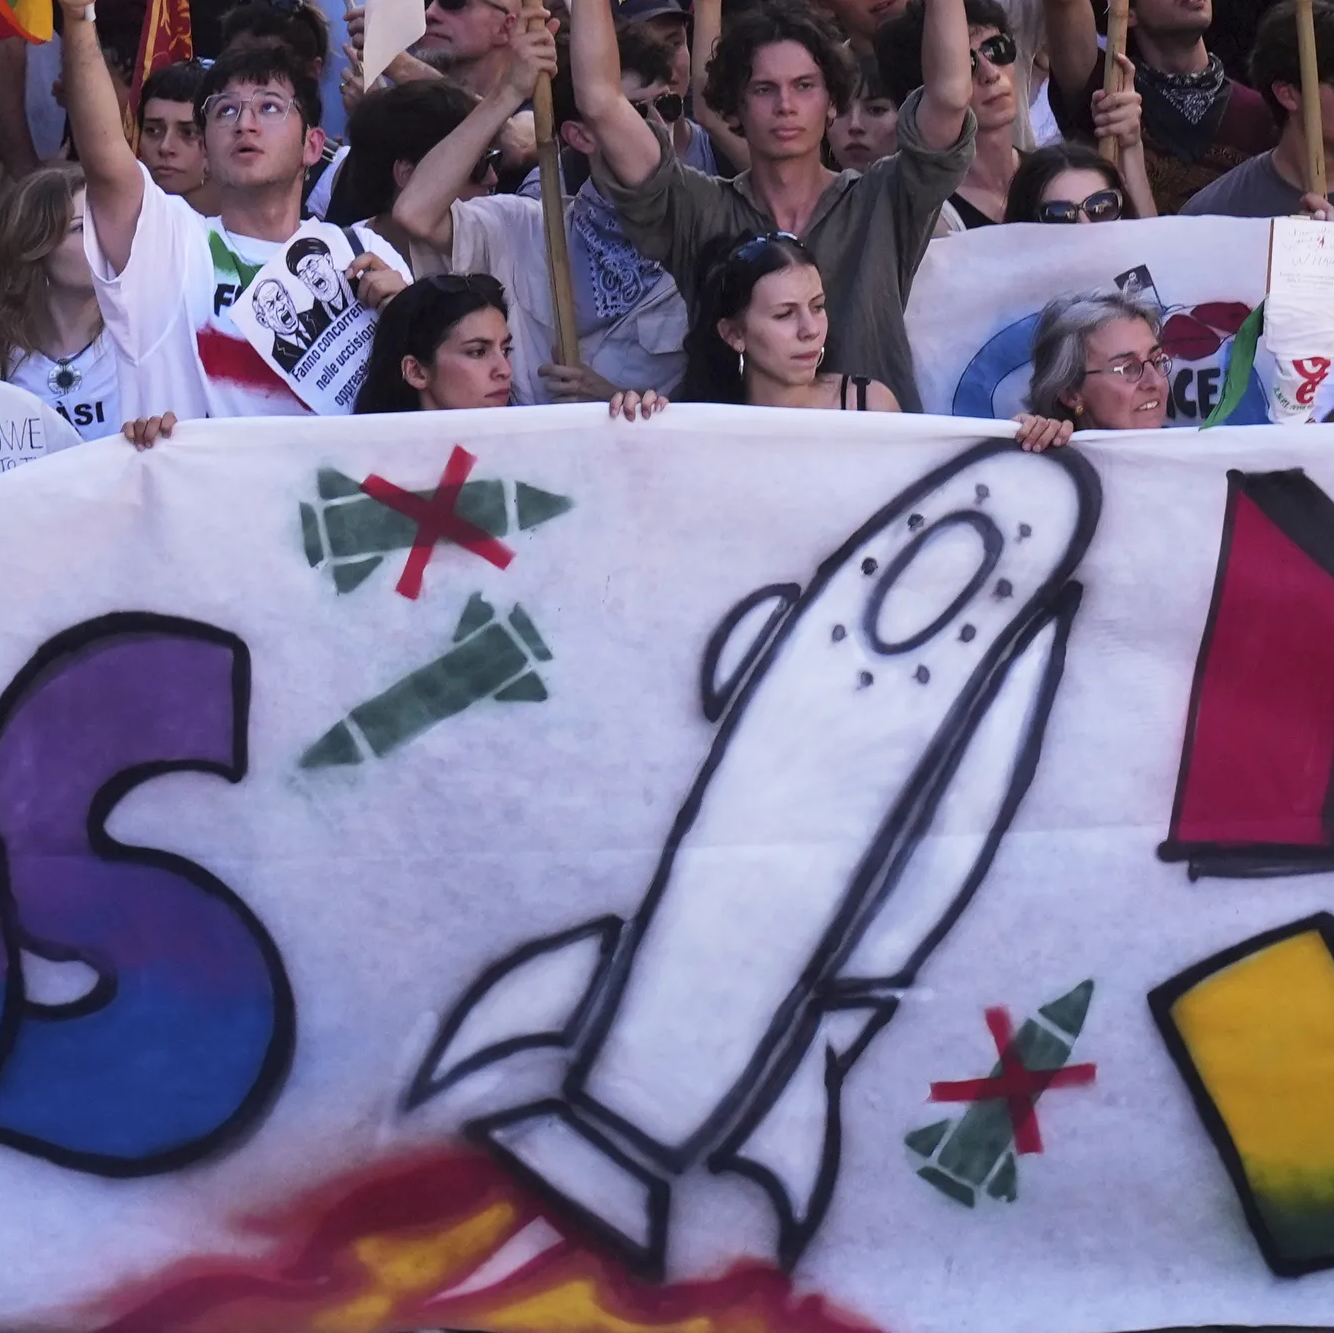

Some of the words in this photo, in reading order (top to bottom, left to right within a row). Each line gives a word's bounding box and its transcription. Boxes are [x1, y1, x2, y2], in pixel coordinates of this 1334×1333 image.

[291, 351, 321, 383] Fanno
[317, 302, 365, 353] concorren
[316, 363, 340, 392] nelle
